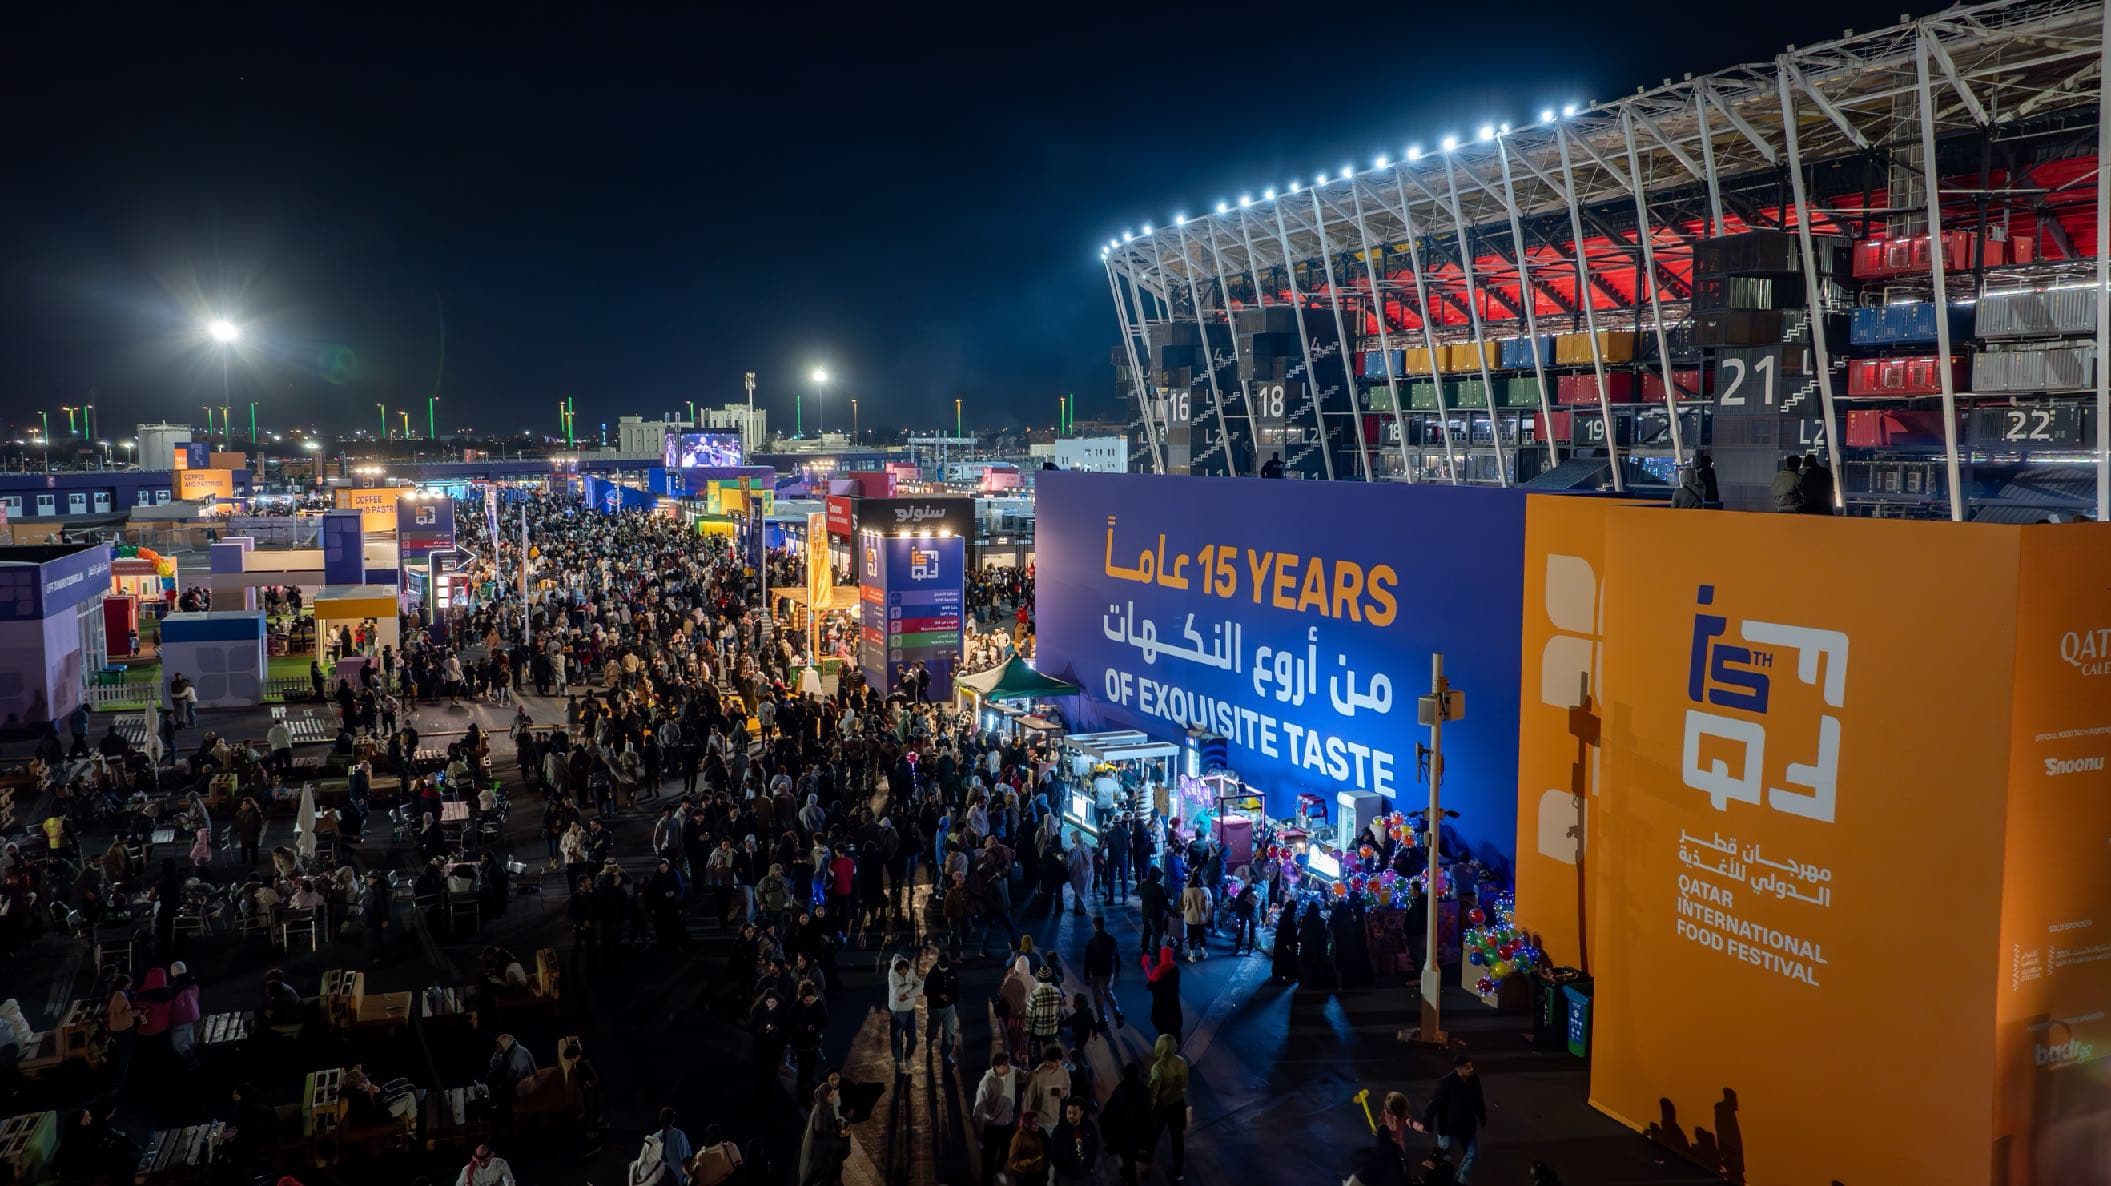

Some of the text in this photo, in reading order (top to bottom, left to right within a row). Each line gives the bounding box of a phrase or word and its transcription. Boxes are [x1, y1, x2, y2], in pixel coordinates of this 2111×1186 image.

[1720, 355, 1775, 405] 21
[1169, 391, 1190, 422] 16
[1259, 385, 1284, 418] 18
[1205, 429, 1224, 444] L2
[1301, 427, 1319, 444] L2
[1387, 423, 1401, 441] 18
[1585, 419, 1605, 441] 19
[1799, 419, 1825, 446] L2
[2006, 411, 2050, 440] 22
[355, 495, 382, 505] COFFEE
[894, 504, 946, 522] سنونو
[1198, 544, 1237, 598] 15
[1248, 548, 1398, 627] YEARS
[1103, 600, 1393, 716] من أروع النكهات
[1105, 668, 1133, 704] OF
[1138, 677, 1279, 759] EXQUISITE
[1283, 721, 1397, 799] TASTE
[2044, 756, 2105, 776] Snoonu
[1679, 829, 1832, 883] مهرجان قطر
[1678, 874, 1734, 908] QATAR
[1679, 845, 1831, 907] الدولي للأغذية
[1677, 895, 1828, 965] INTERNATIONAL
[1677, 918, 1820, 987] FOOD FESTIVAL
